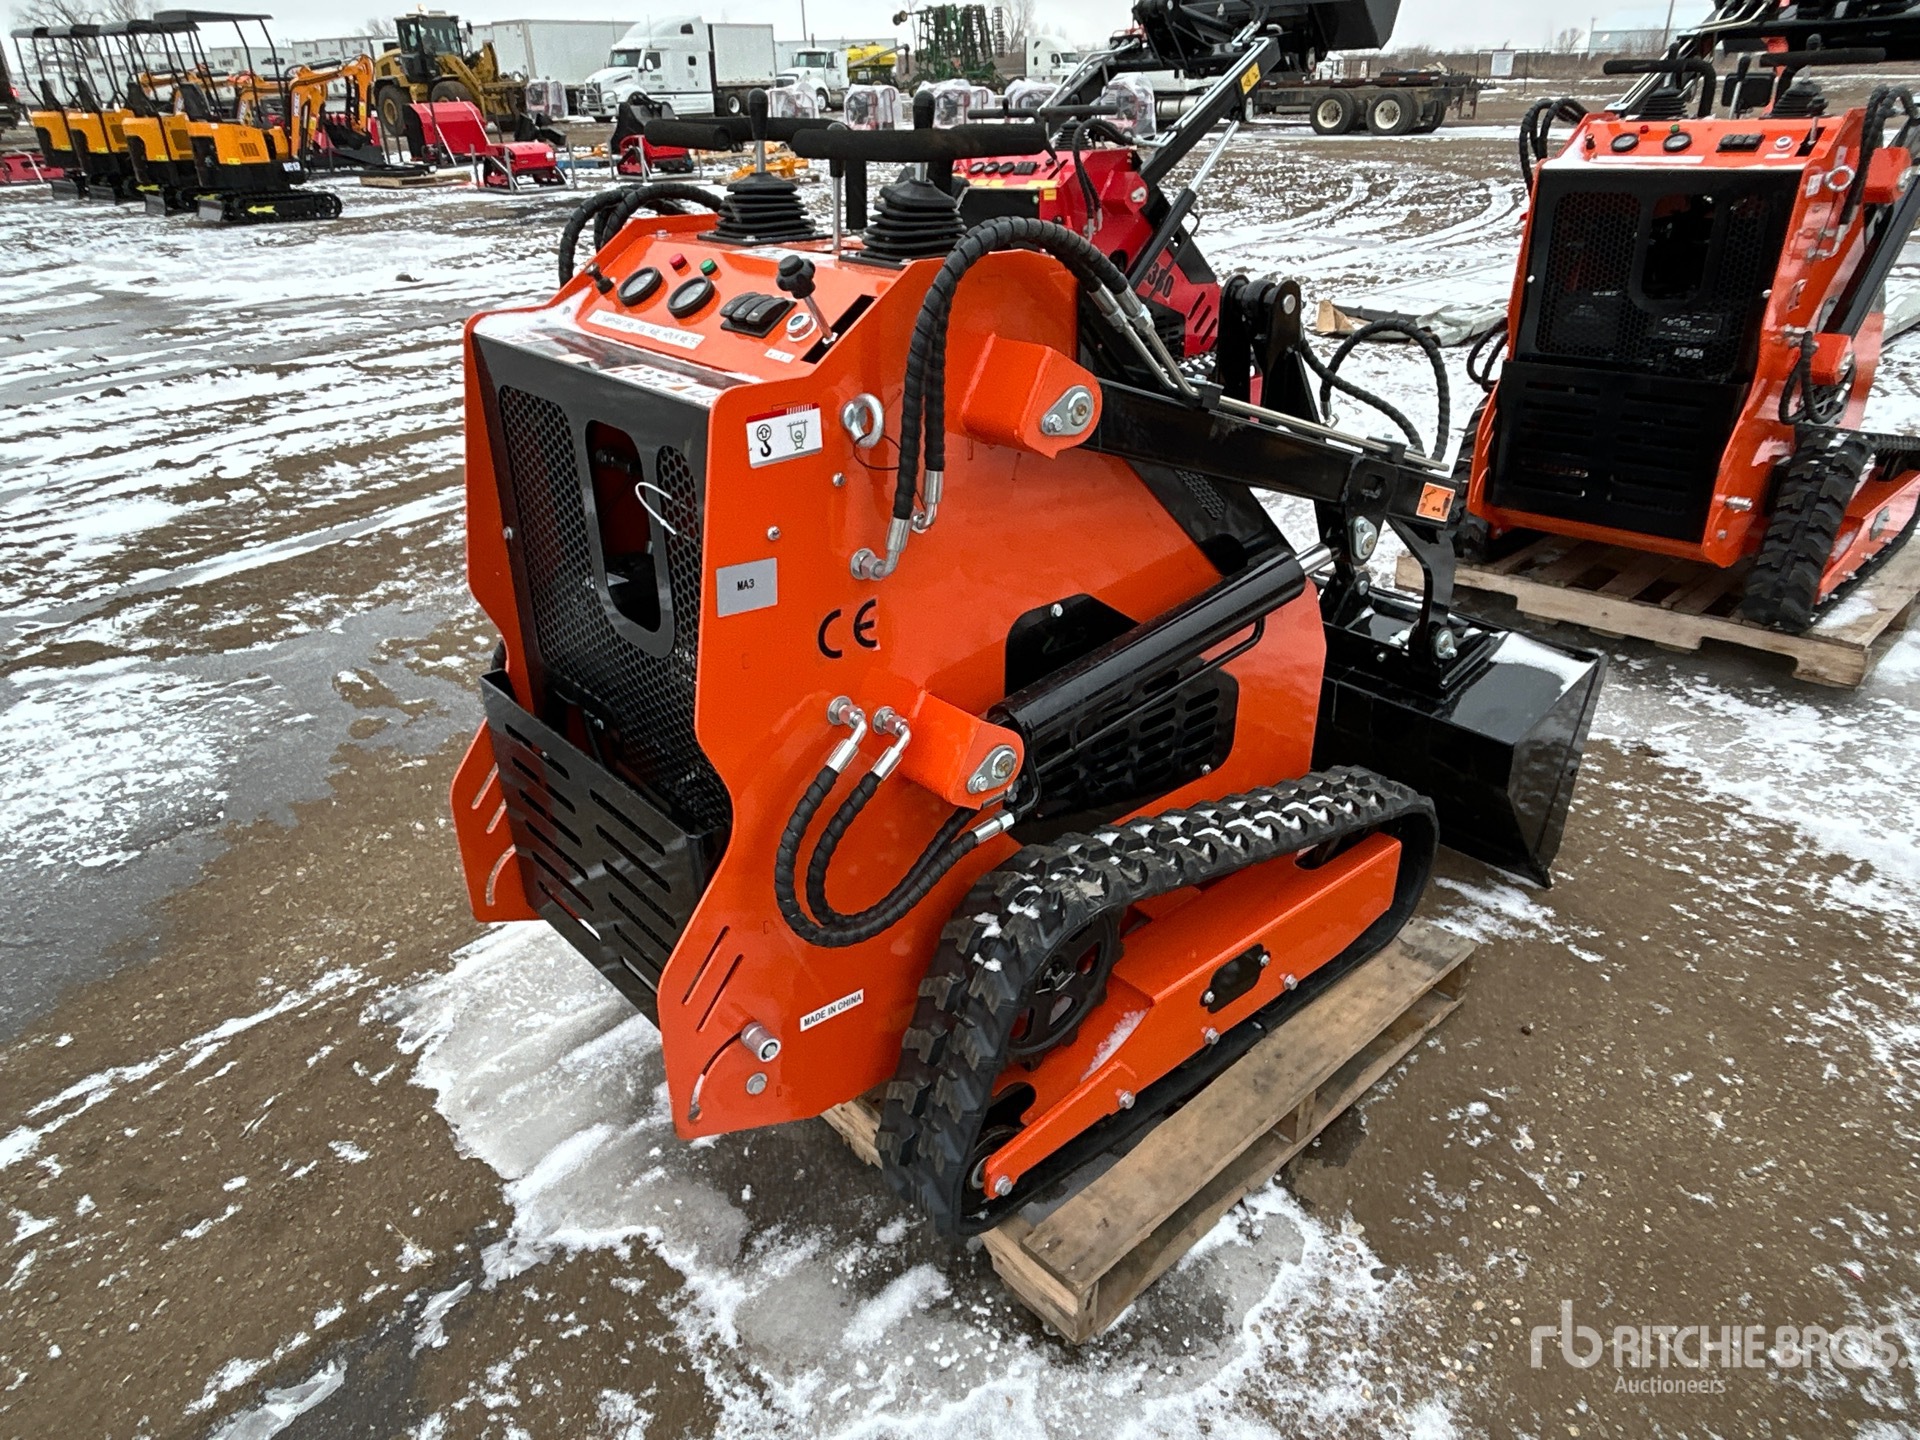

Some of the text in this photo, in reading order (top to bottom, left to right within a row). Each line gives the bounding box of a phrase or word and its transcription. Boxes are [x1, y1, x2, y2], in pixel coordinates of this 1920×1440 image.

[737, 578, 755, 591] MA3
[817, 598, 878, 659] CE
[804, 994, 861, 1026] MADE IN CHINA
